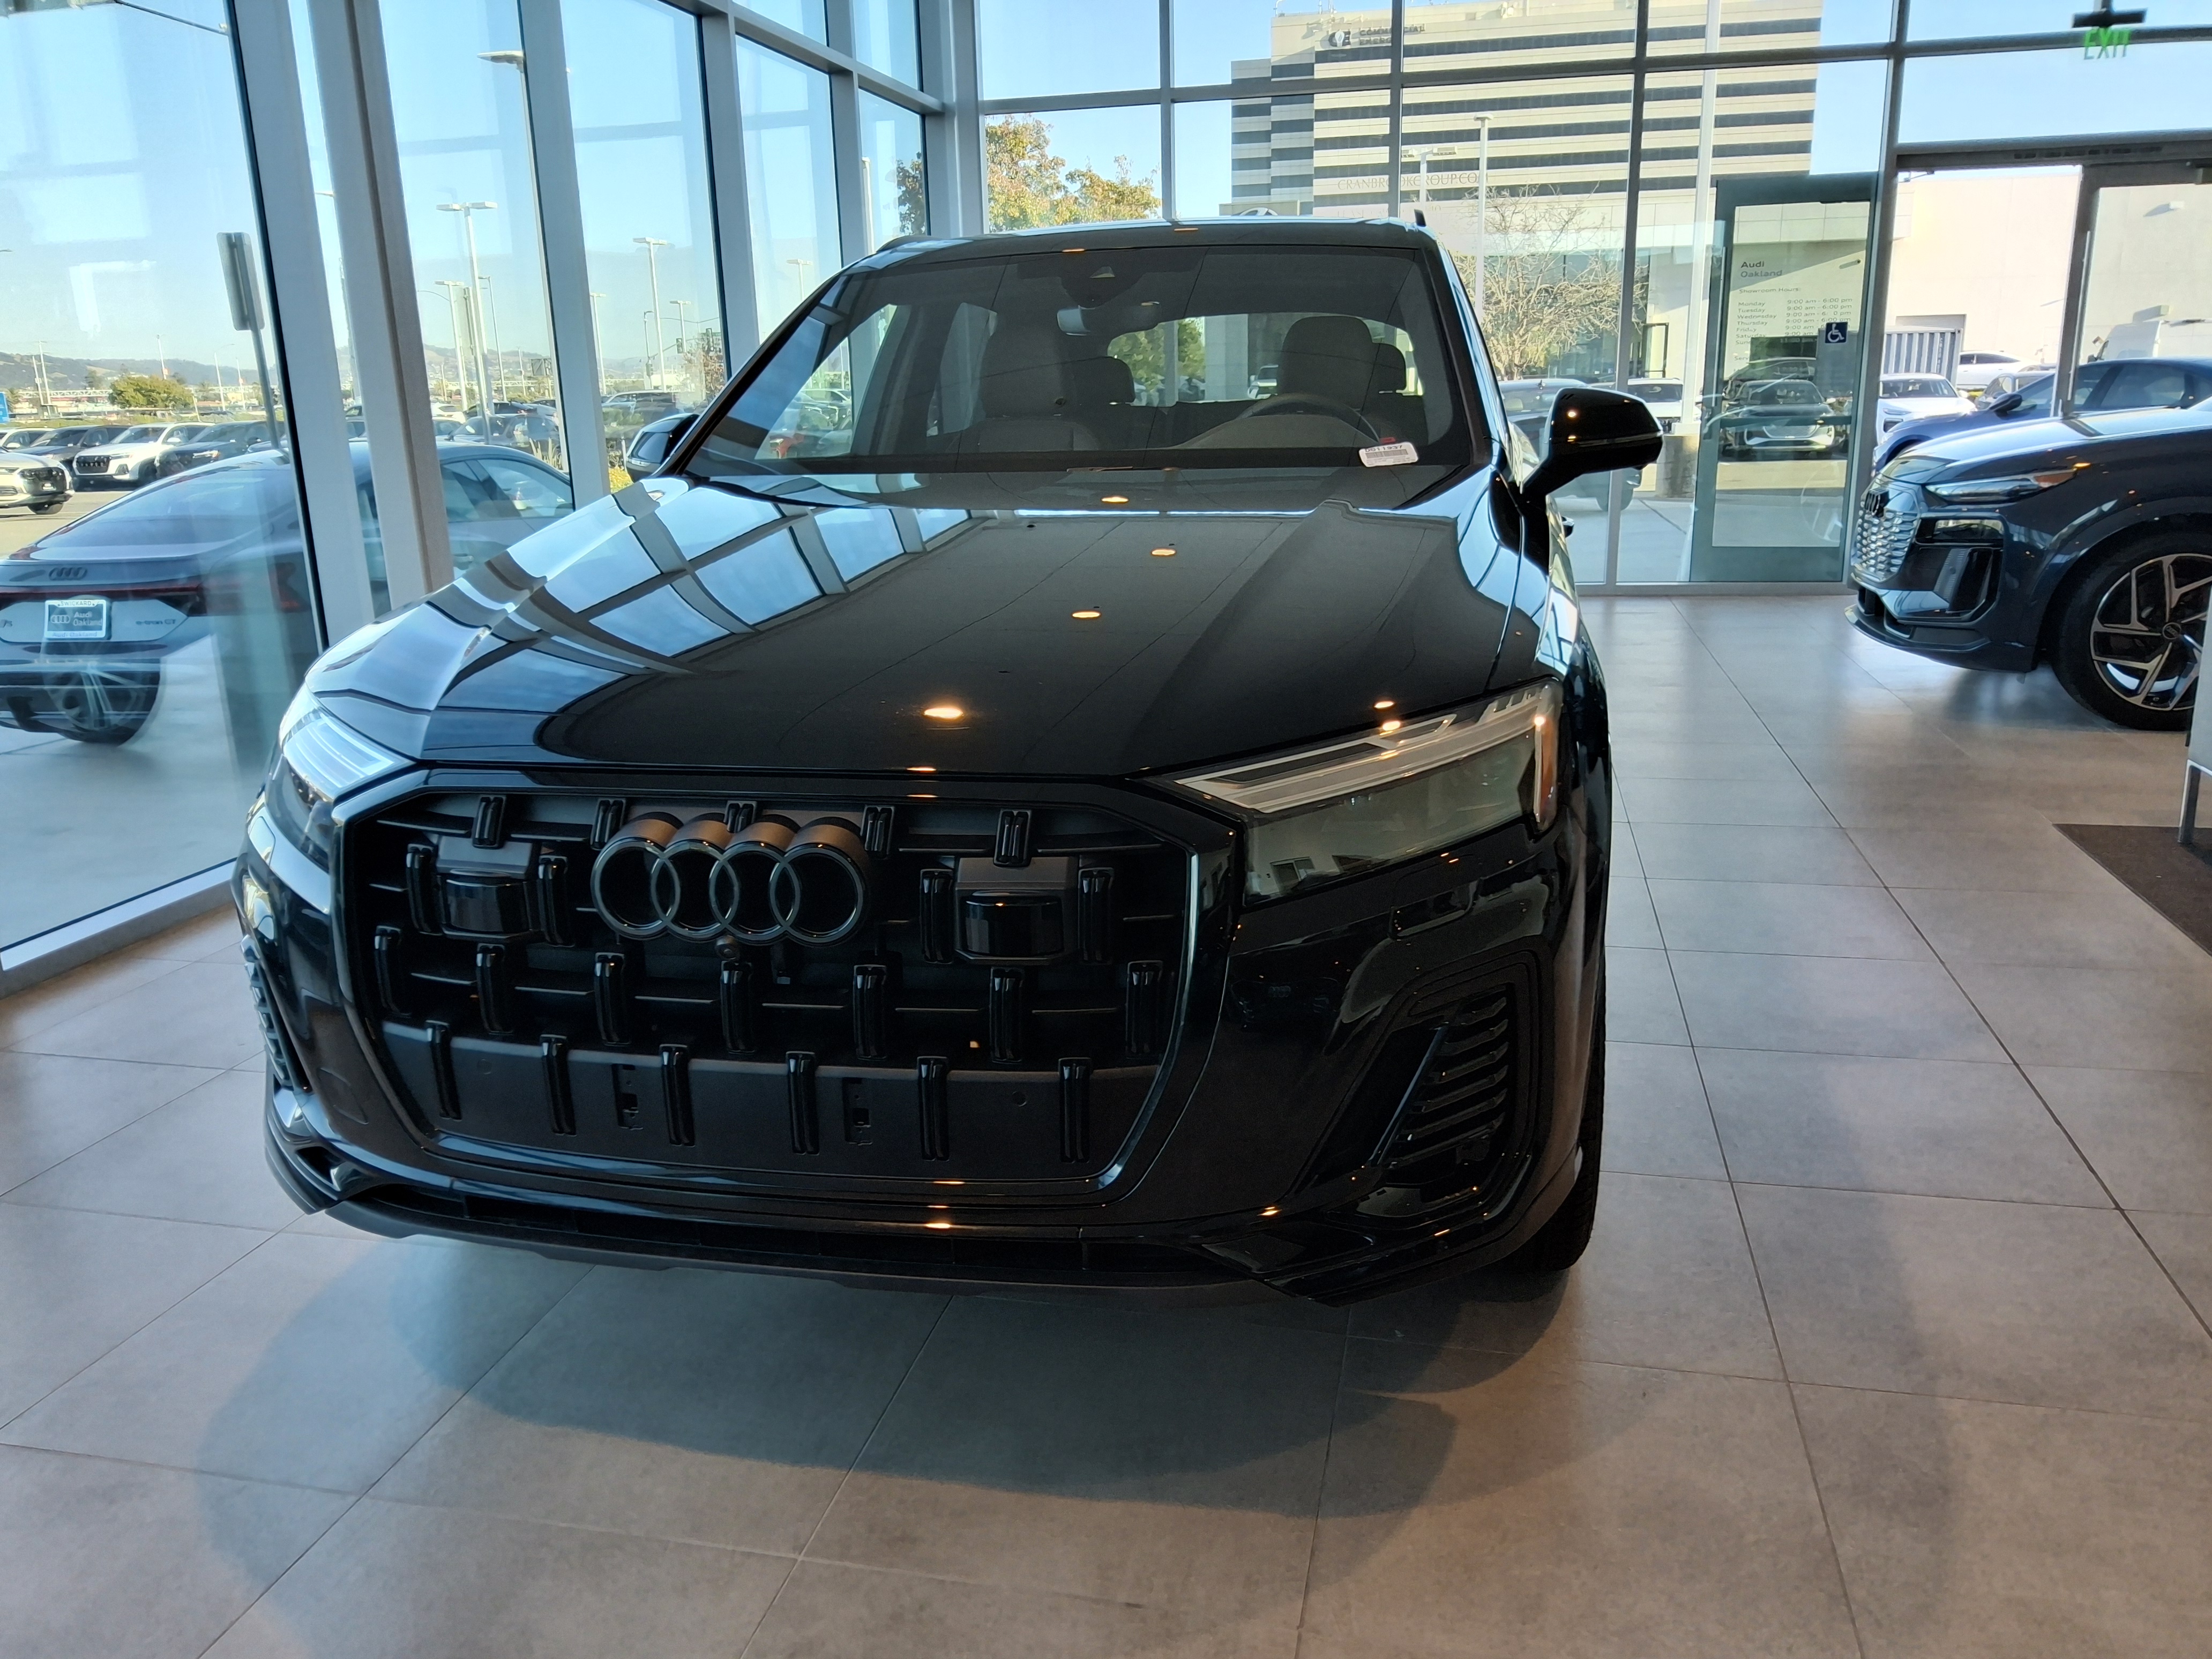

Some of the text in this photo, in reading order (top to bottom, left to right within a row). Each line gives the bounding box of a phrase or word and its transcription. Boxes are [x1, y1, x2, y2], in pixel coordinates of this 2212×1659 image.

[2084, 27, 2131, 60] EXIT
[1337, 172, 1488, 190] CRANBRKGROUP.CO
[1740, 270, 1782, 278] Oakland
